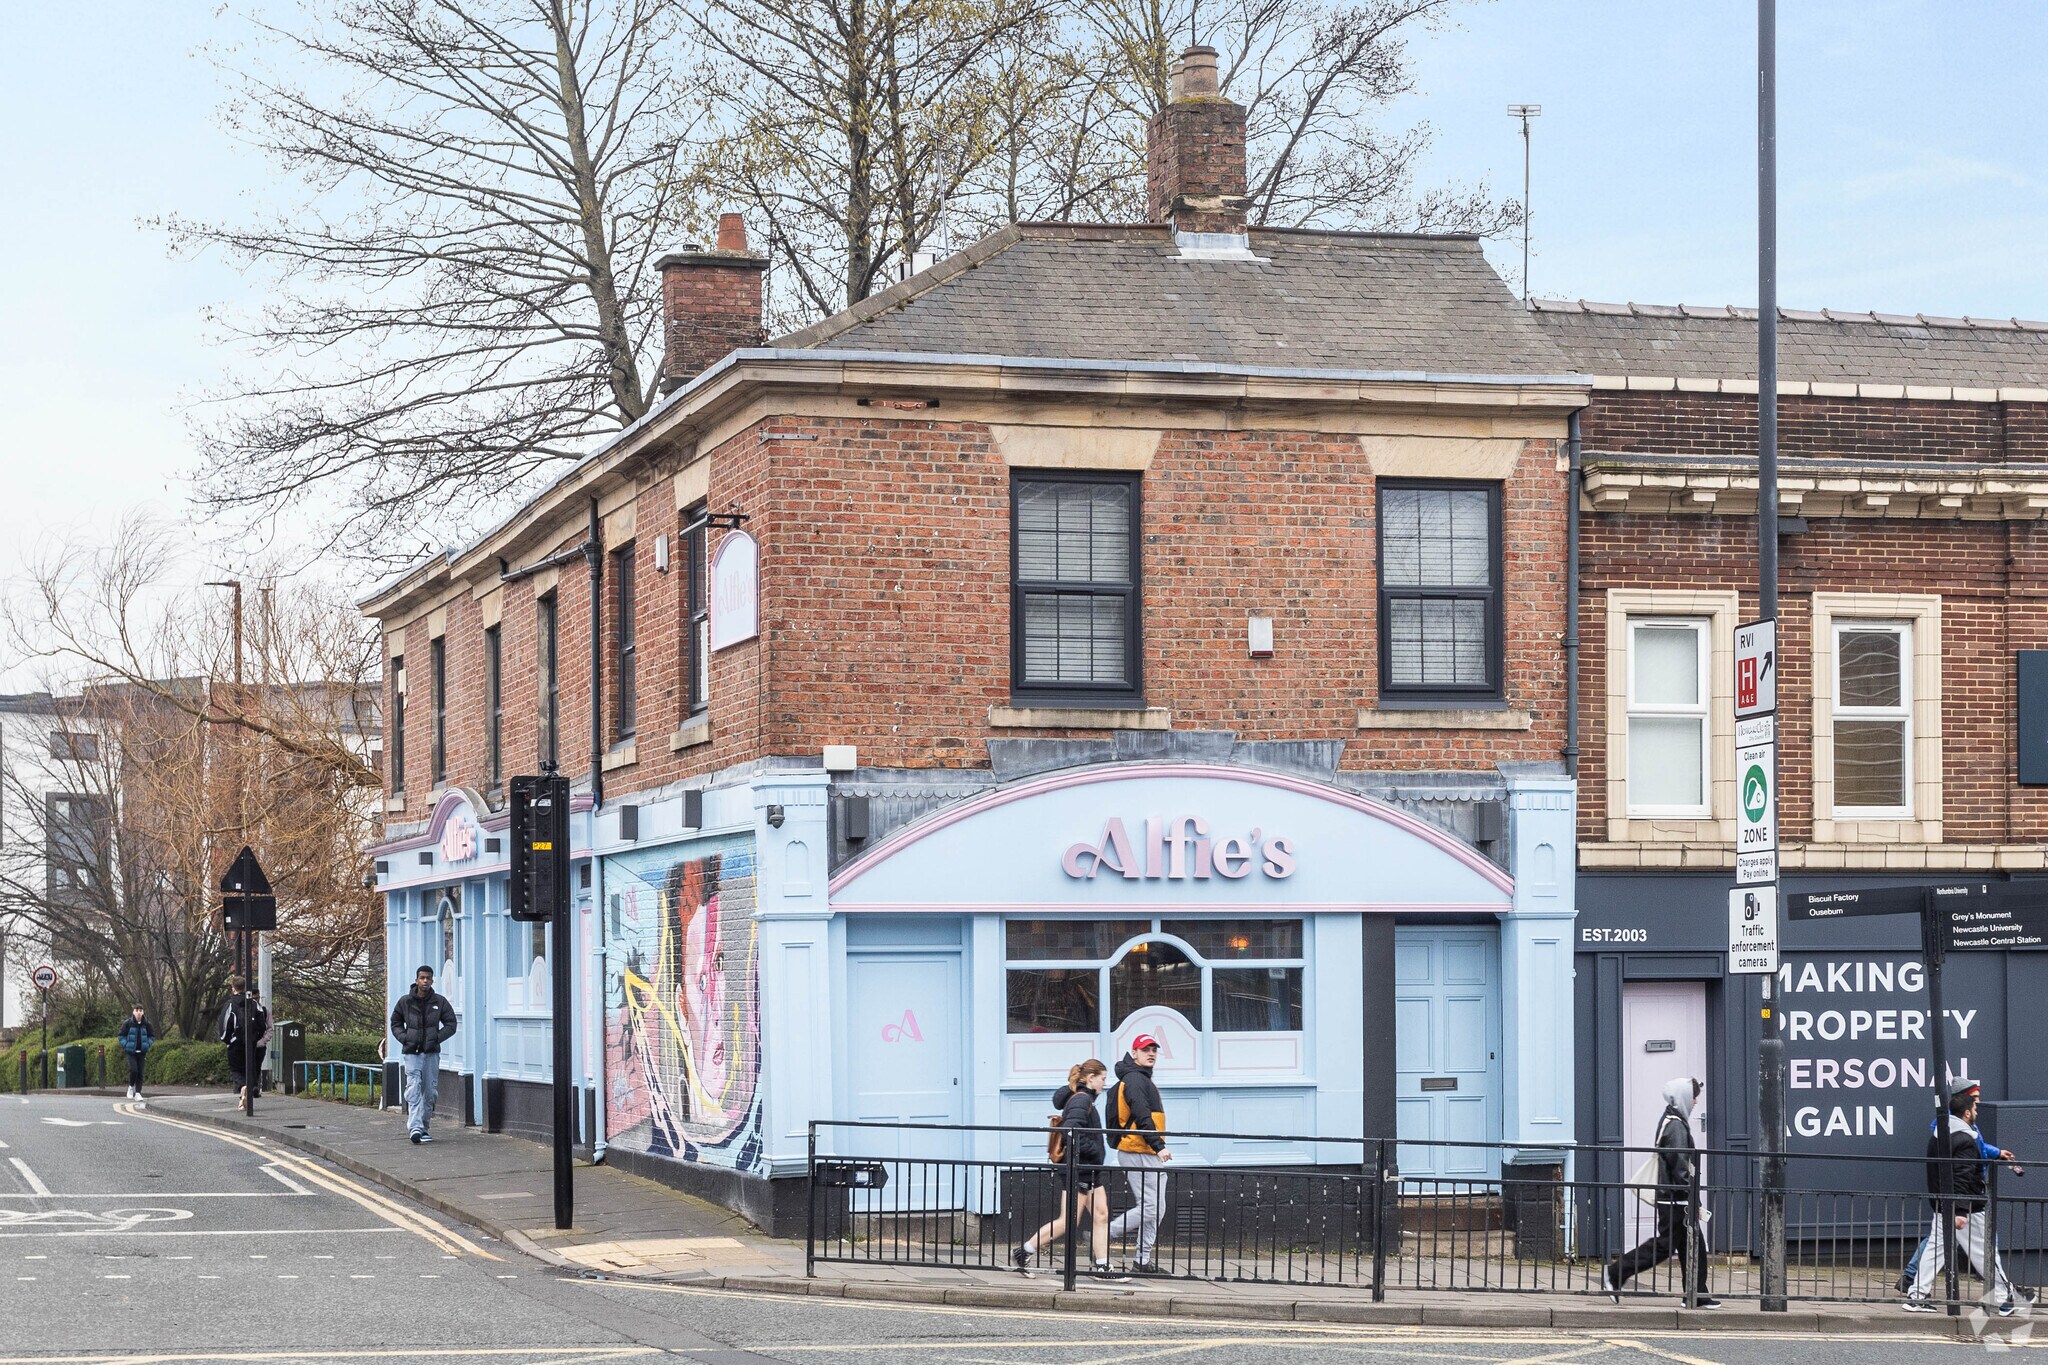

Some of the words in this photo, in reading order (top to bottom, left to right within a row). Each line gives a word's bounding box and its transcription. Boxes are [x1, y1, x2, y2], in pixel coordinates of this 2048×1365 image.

[1740, 632, 1754, 648] RVI
[1742, 660, 1753, 691] H
[1744, 751, 1758, 761] Clean
[1744, 827, 1767, 843] ZONE
[1061, 815, 1297, 879] Alfie's
[1739, 857, 1759, 868] Charges
[1760, 855, 1773, 866] apply
[1743, 869, 1752, 880] Pay
[1753, 868, 1769, 877] online
[1808, 895, 1832, 904] Biscuit
[1833, 893, 1859, 903] Factory
[1809, 907, 1843, 917] Ouseburn
[1952, 912, 1974, 922] Grey's
[1976, 911, 2012, 920] Monument
[1582, 928, 1647, 942] EST.2003
[1742, 924, 1764, 937] Traffic
[1953, 925, 1989, 934] Newcastle
[1990, 923, 2023, 933] University
[1731, 940, 1775, 953] enforcement
[1954, 938, 1989, 947] Newcastle
[1991, 936, 2015, 945] Central
[2017, 935, 2041, 944] Station
[1738, 957, 1768, 968] cameras
[1779, 1009, 1977, 1041] ROPERY
[289, 1029, 299, 1037] 48
[1786, 1105, 1894, 1137] GAIN
